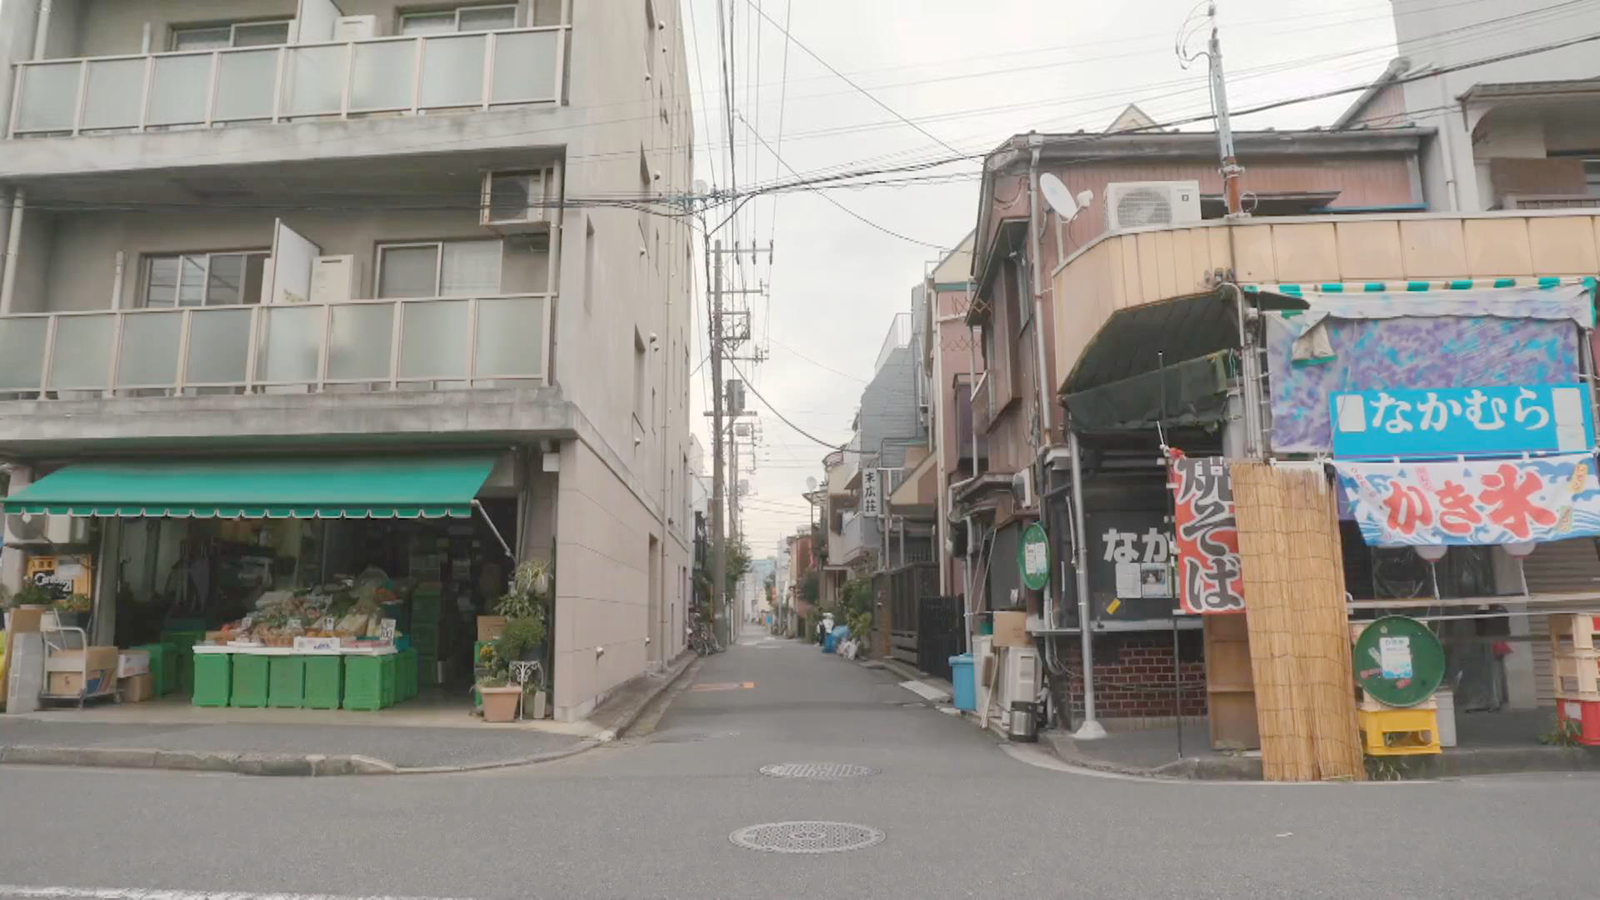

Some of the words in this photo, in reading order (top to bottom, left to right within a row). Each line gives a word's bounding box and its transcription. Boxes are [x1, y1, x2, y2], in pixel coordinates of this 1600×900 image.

[1369, 386, 1550, 434] なかむら
[865, 471, 876, 512] 末広荘
[1383, 463, 1558, 539] かき氷
[1175, 457, 1243, 612] 焼そば
